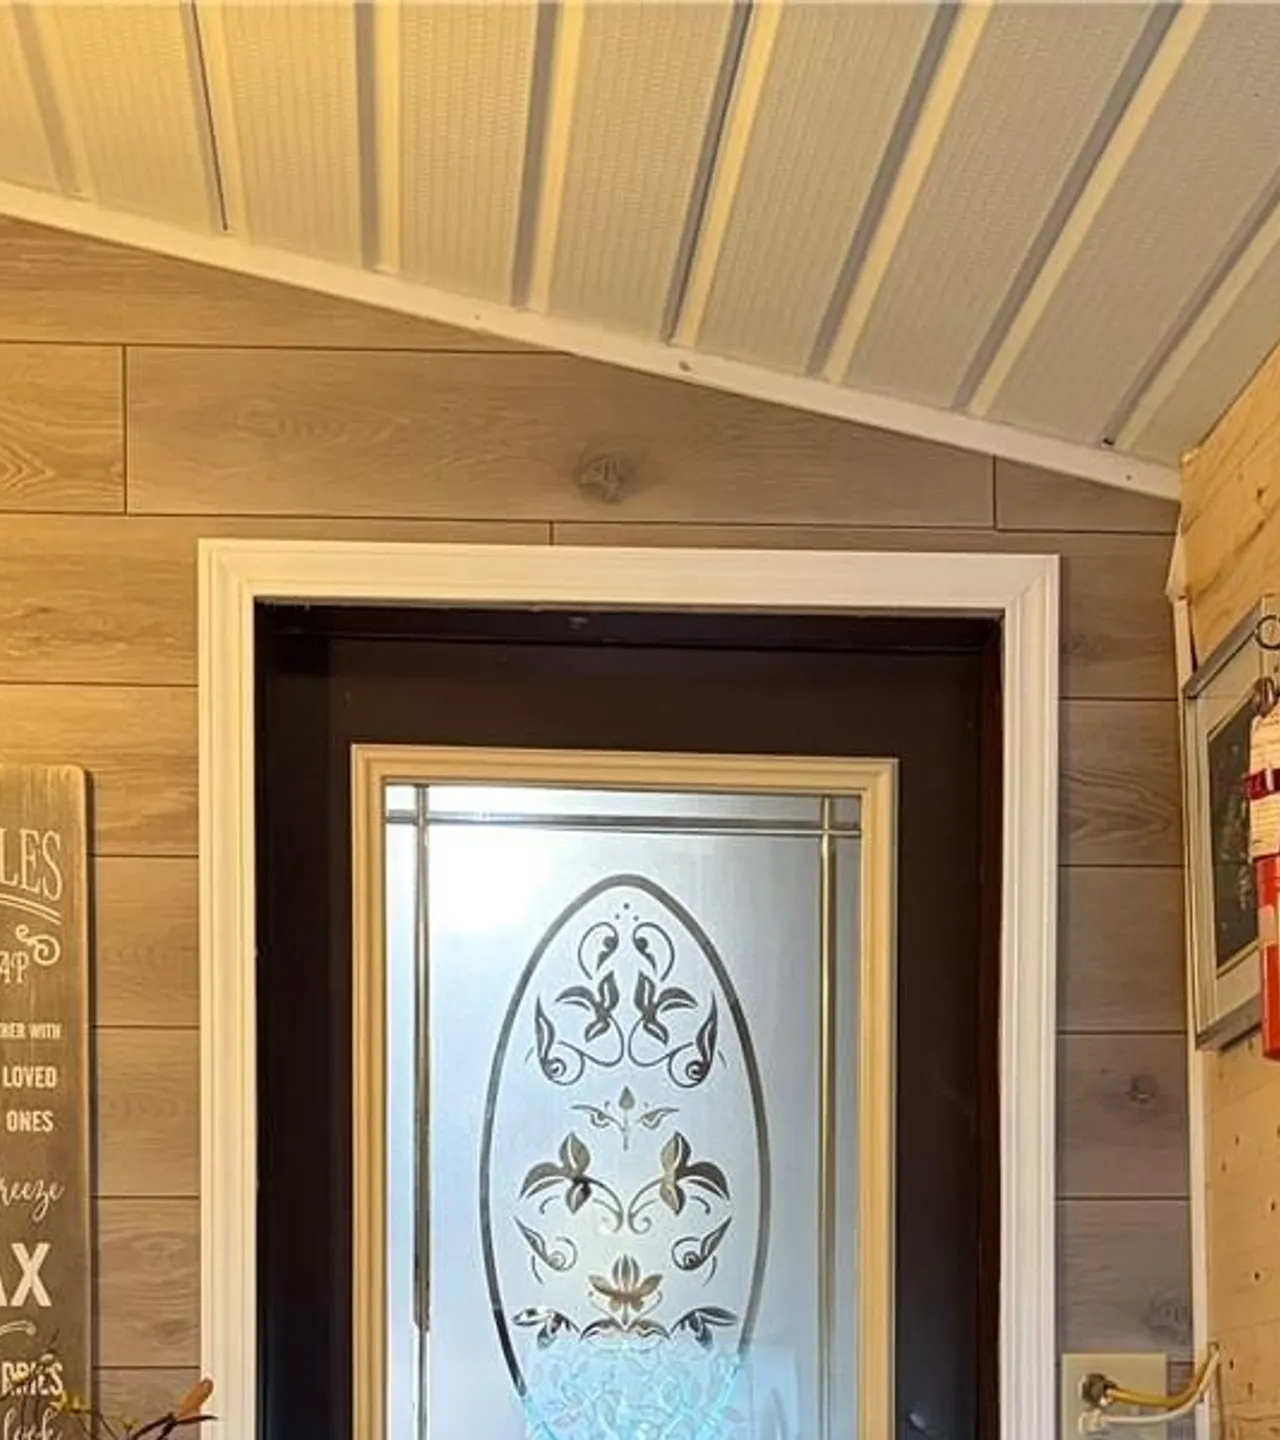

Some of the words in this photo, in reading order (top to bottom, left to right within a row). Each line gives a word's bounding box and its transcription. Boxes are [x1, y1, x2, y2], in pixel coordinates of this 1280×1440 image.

[28, 1022, 64, 1041] WITH
[2, 1065, 58, 1090] LOVED
[5, 1109, 55, 1133] ONES
